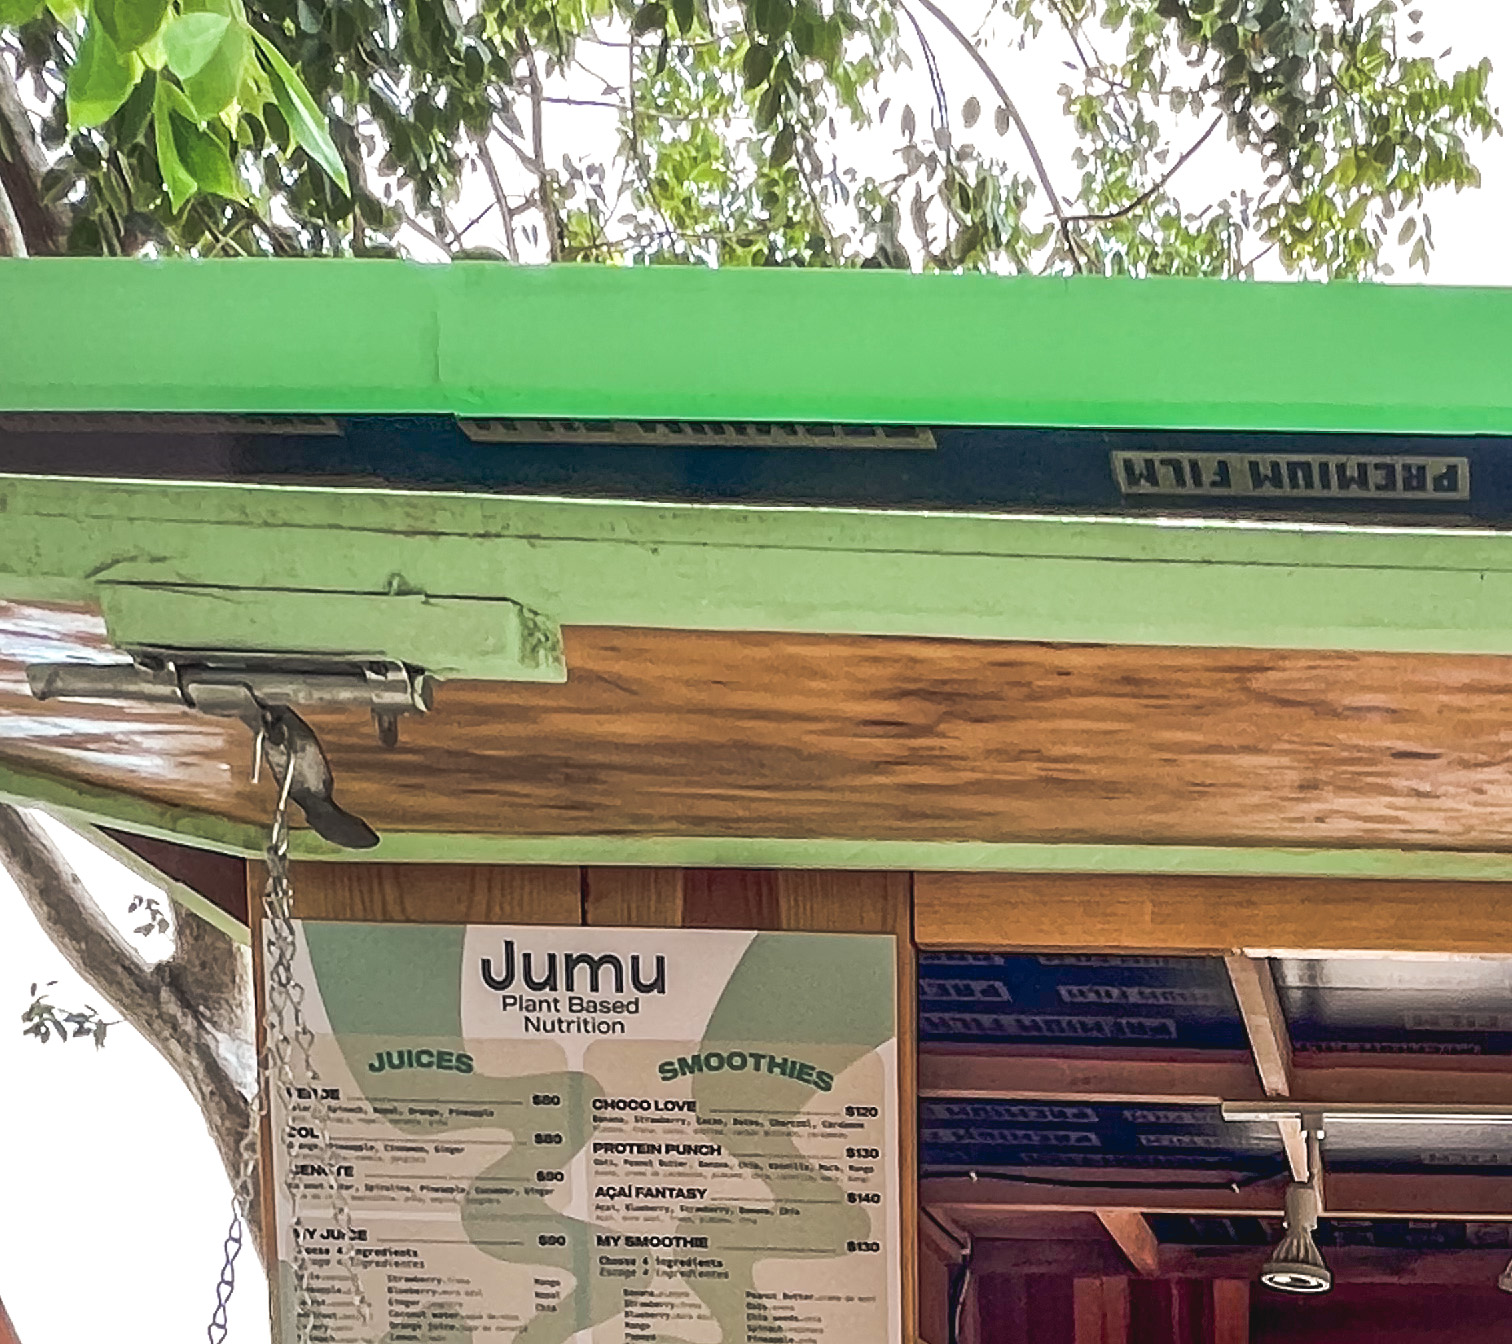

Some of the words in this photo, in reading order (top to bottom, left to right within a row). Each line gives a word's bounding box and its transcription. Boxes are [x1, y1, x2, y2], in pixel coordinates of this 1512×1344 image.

[1123, 457, 1232, 490] FILM
[1248, 459, 1459, 493] PREMIUM
[480, 939, 666, 995] Jumu
[502, 994, 560, 1013] Plant
[568, 996, 640, 1014] Based
[523, 1015, 626, 1035] Nutrition
[368, 1049, 474, 1074] JUICES
[658, 1051, 835, 1093] SMOOTHIES
[592, 1098, 652, 1112] CHOCO
[654, 1099, 697, 1113] LOVE
[592, 1142, 662, 1155] PROTEIN
[664, 1143, 723, 1156] PUNCH
[594, 1183, 633, 1201] AÇAÍ
[634, 1186, 708, 1201] FANTASY
[846, 1191, 882, 1204] $140
[595, 1235, 621, 1248] MY
[624, 1235, 709, 1249] SMOOTHIE
